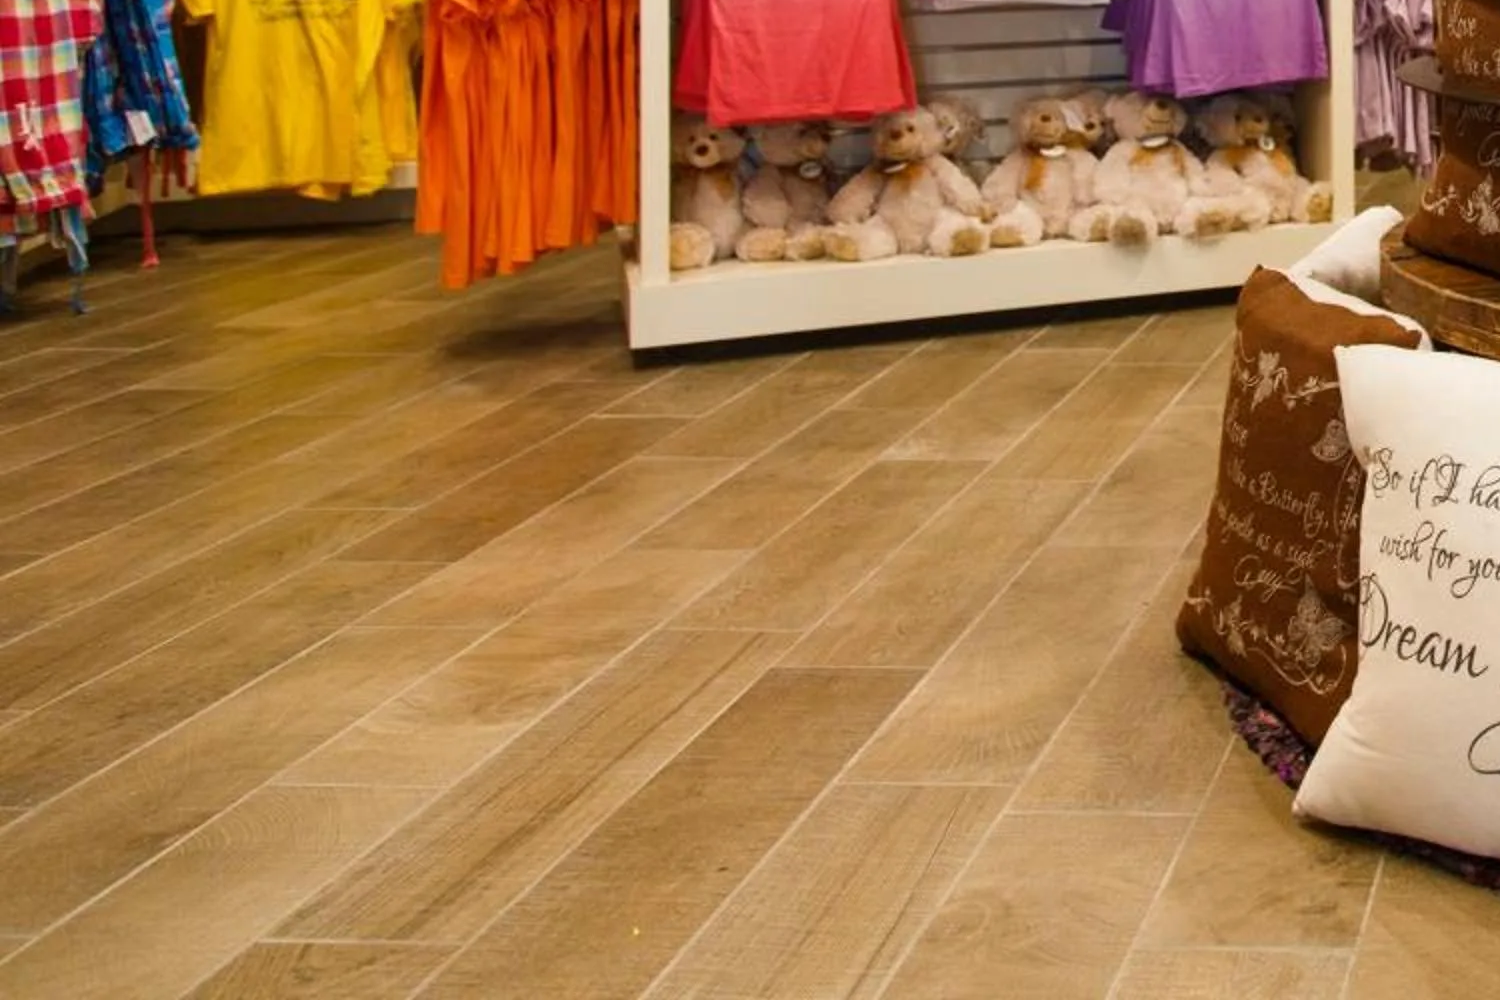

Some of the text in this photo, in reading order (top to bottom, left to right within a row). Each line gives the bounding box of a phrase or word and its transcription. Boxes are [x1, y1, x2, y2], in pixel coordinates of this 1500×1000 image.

[1409, 456, 1438, 510] if
[1431, 453, 1466, 506] I
[1379, 520, 1435, 563] wish
[1427, 529, 1462, 581] for
[1358, 572, 1489, 678] Dream
